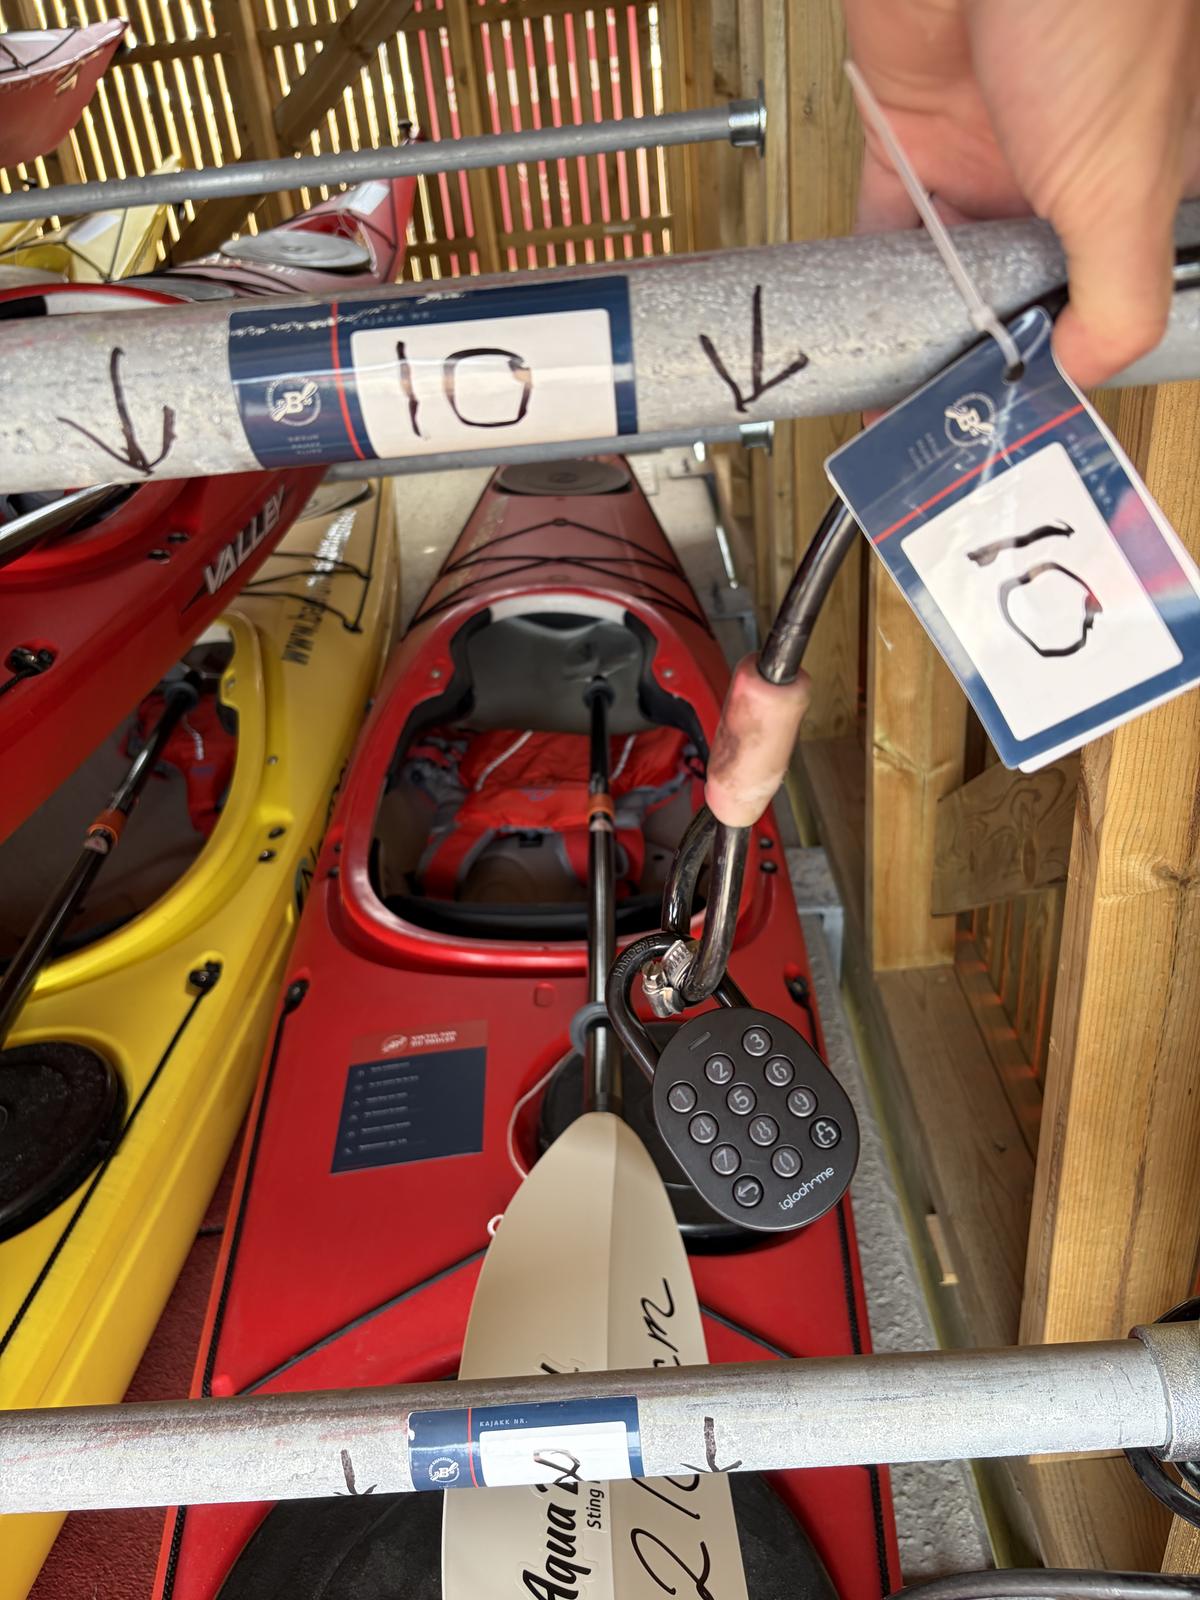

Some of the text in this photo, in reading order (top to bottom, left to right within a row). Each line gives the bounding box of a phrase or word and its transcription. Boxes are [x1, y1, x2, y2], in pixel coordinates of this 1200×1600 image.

[397, 341, 533, 440] 10
[204, 484, 286, 594] VALLEY
[967, 519, 1103, 658] 10
[613, 936, 662, 977] HARDENED
[750, 1033, 765, 1050] 3
[712, 1061, 728, 1080] 2
[772, 1062, 787, 1080] 6
[676, 1090, 688, 1104] 1
[733, 1090, 749, 1109] 5
[794, 1093, 810, 1110] 9
[699, 1119, 712, 1137] 4
[755, 1121, 772, 1140] 8
[716, 1149, 728, 1169] 7
[779, 1152, 795, 1171] 0
[479, 1418, 510, 1428] KAJAKK
[587, 1488, 605, 1529] Sting
[522, 1502, 592, 1600] Aqua
